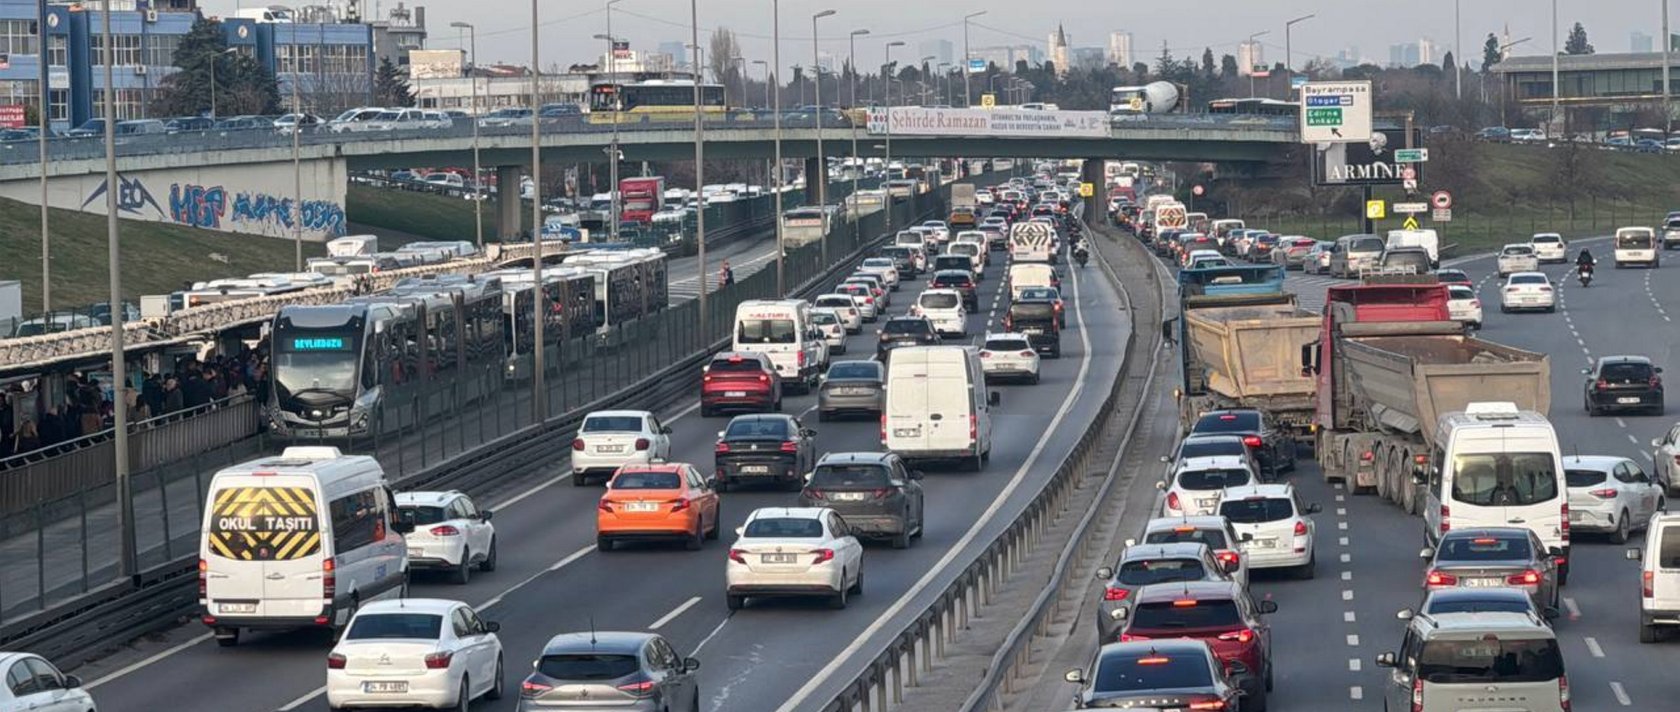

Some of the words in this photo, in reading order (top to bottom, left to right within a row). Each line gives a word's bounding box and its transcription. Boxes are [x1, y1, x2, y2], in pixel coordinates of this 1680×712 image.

[1308, 109, 1338, 117] Edirne
[219, 517, 257, 530] OKUL
[265, 517, 312, 533] TAŞITI
